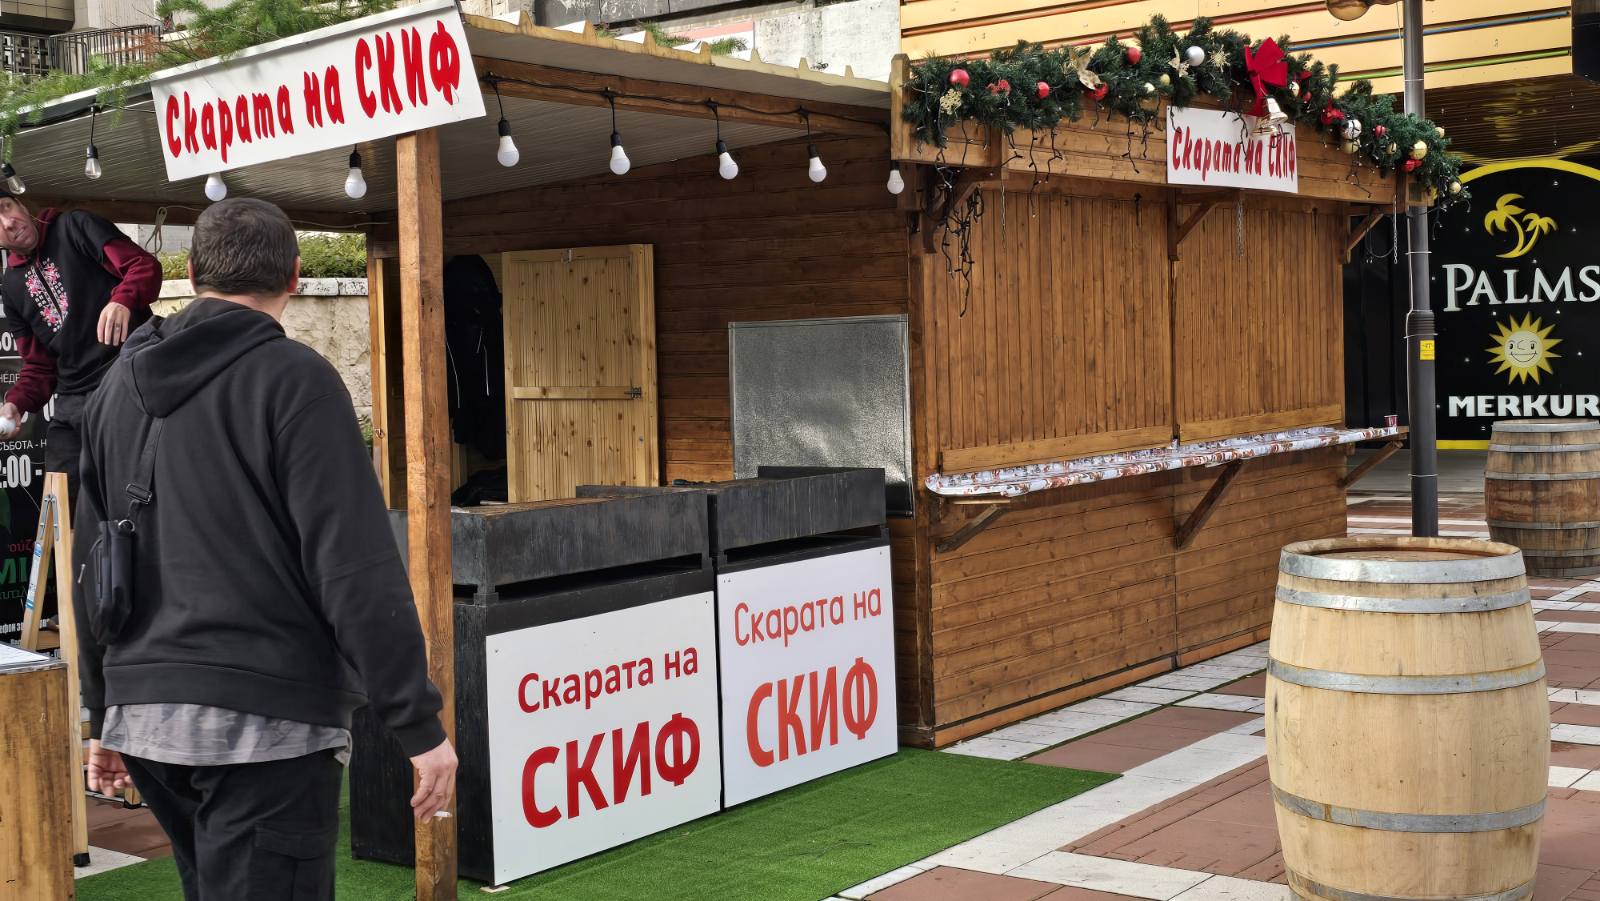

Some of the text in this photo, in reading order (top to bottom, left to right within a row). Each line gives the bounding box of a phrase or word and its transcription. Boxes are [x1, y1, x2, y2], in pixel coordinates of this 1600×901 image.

[166, 20, 461, 164] Скарата на СКИФ
[1172, 126, 1242, 182] Скарата
[1245, 138, 1264, 176] на
[1442, 263, 1600, 312] PALMS
[1448, 394, 1600, 418] MERKUR
[0, 454, 31, 489] :00
[733, 587, 882, 647] Скарата на
[517, 646, 699, 714] Скарата на
[746, 656, 879, 768] СКИФ
[521, 712, 701, 829] СКИФ
